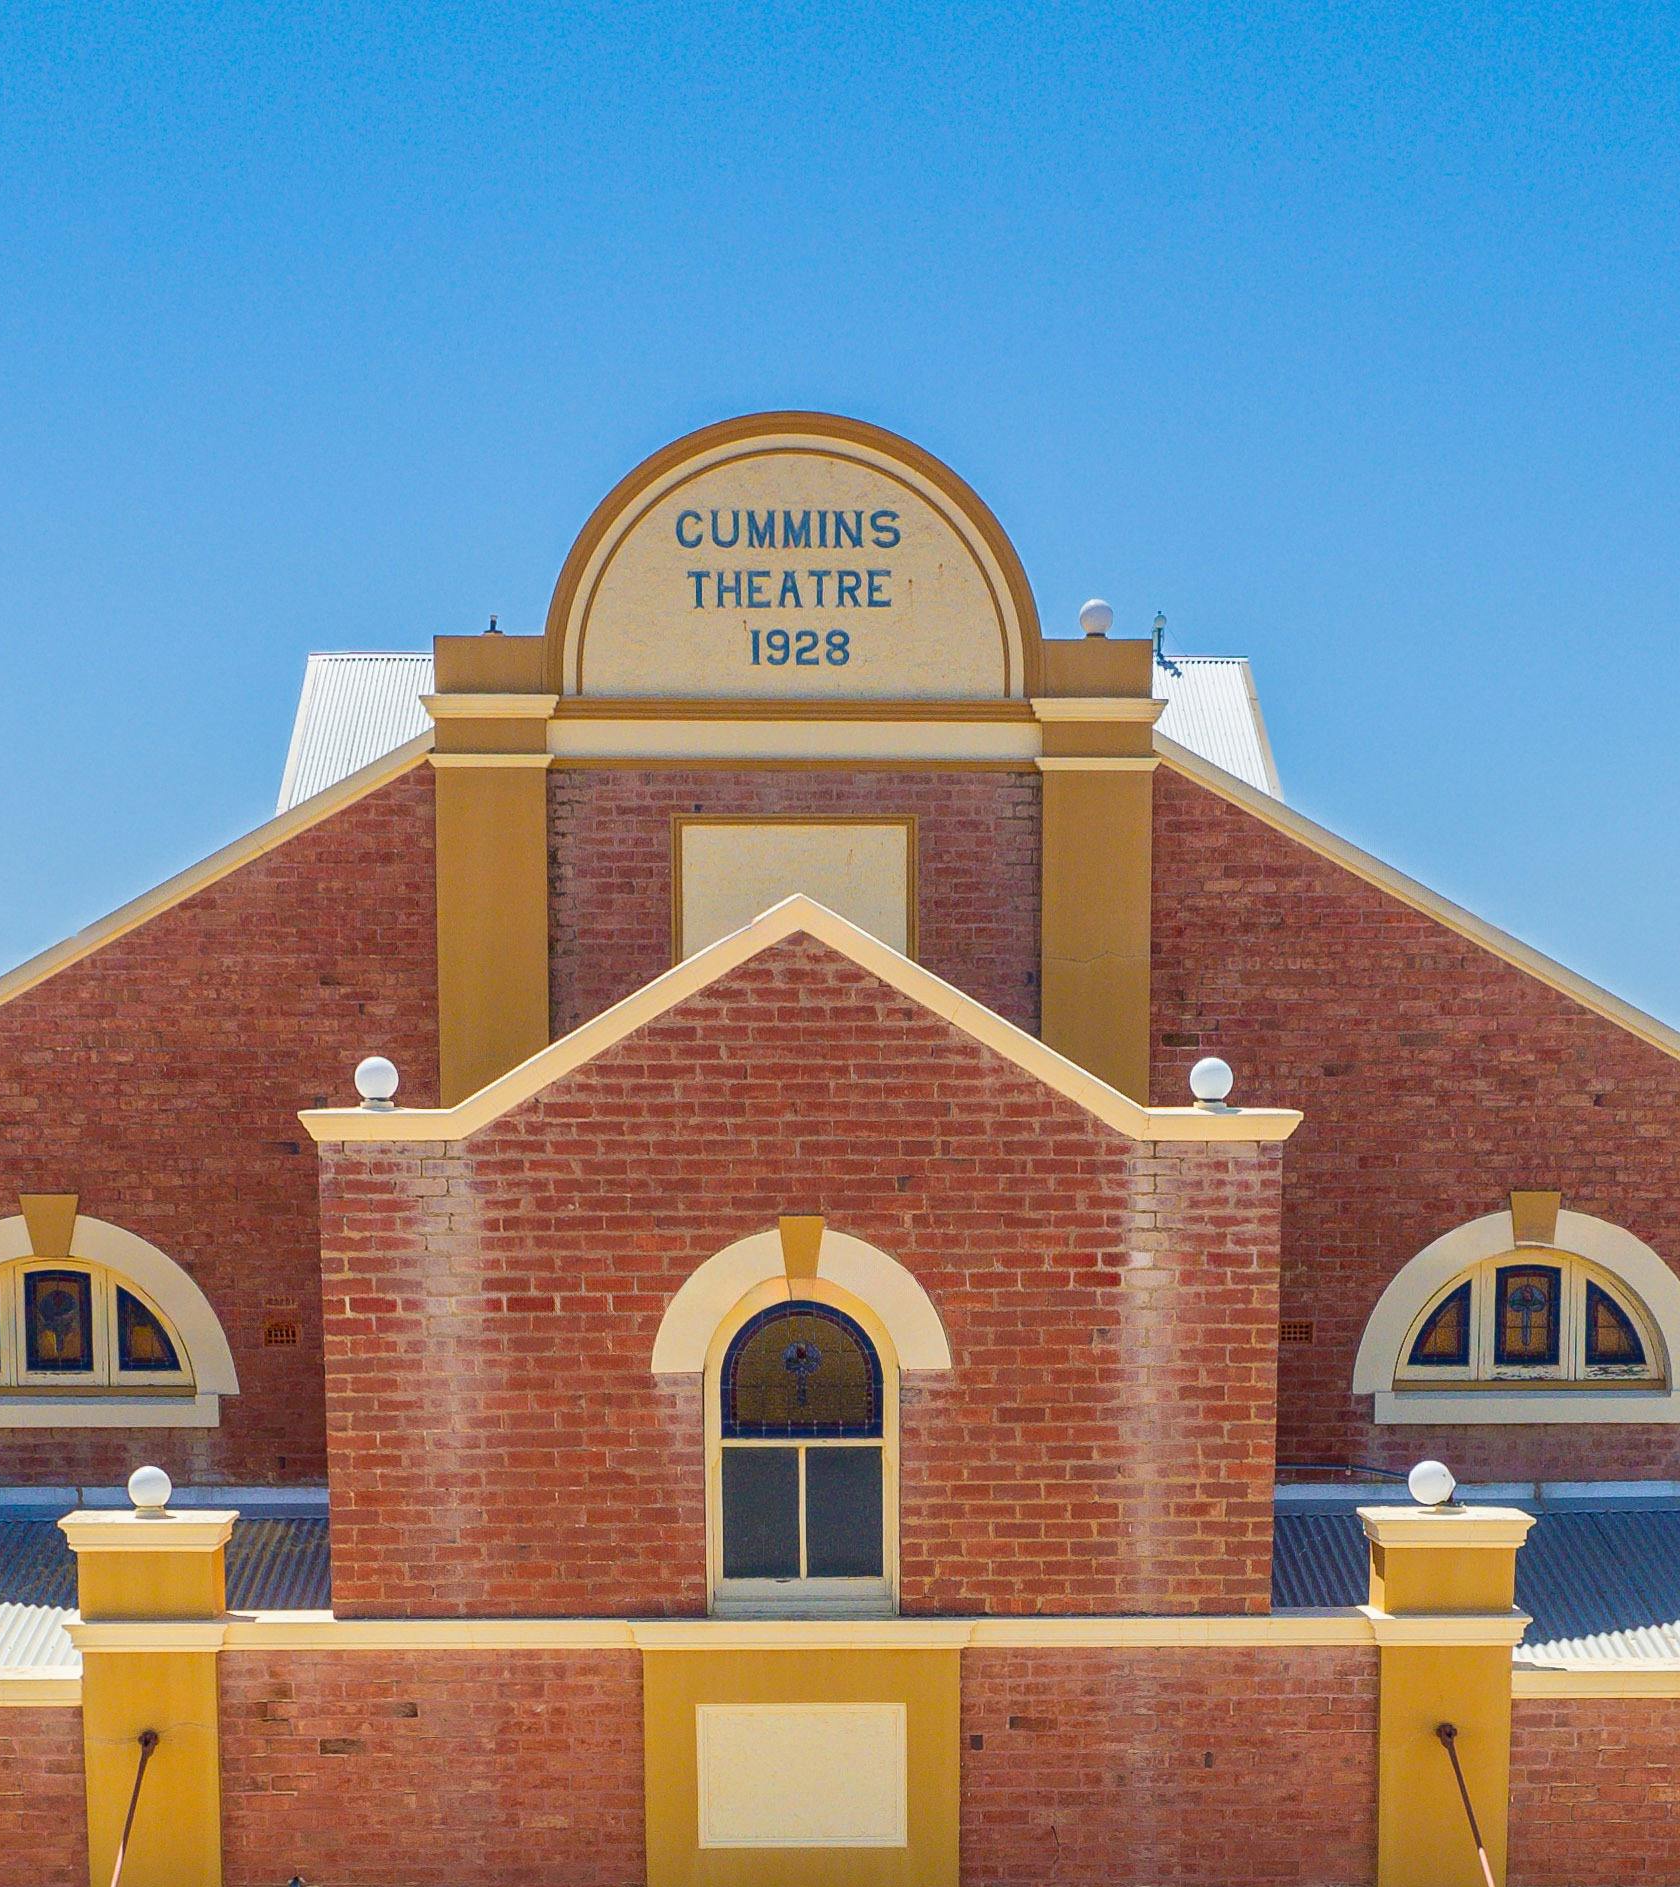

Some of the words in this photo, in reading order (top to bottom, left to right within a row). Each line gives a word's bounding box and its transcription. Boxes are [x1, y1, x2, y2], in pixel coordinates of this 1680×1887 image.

[675, 509, 901, 548] CUMMINS
[686, 570, 893, 609] THEATRE
[750, 629, 851, 667] 1928
